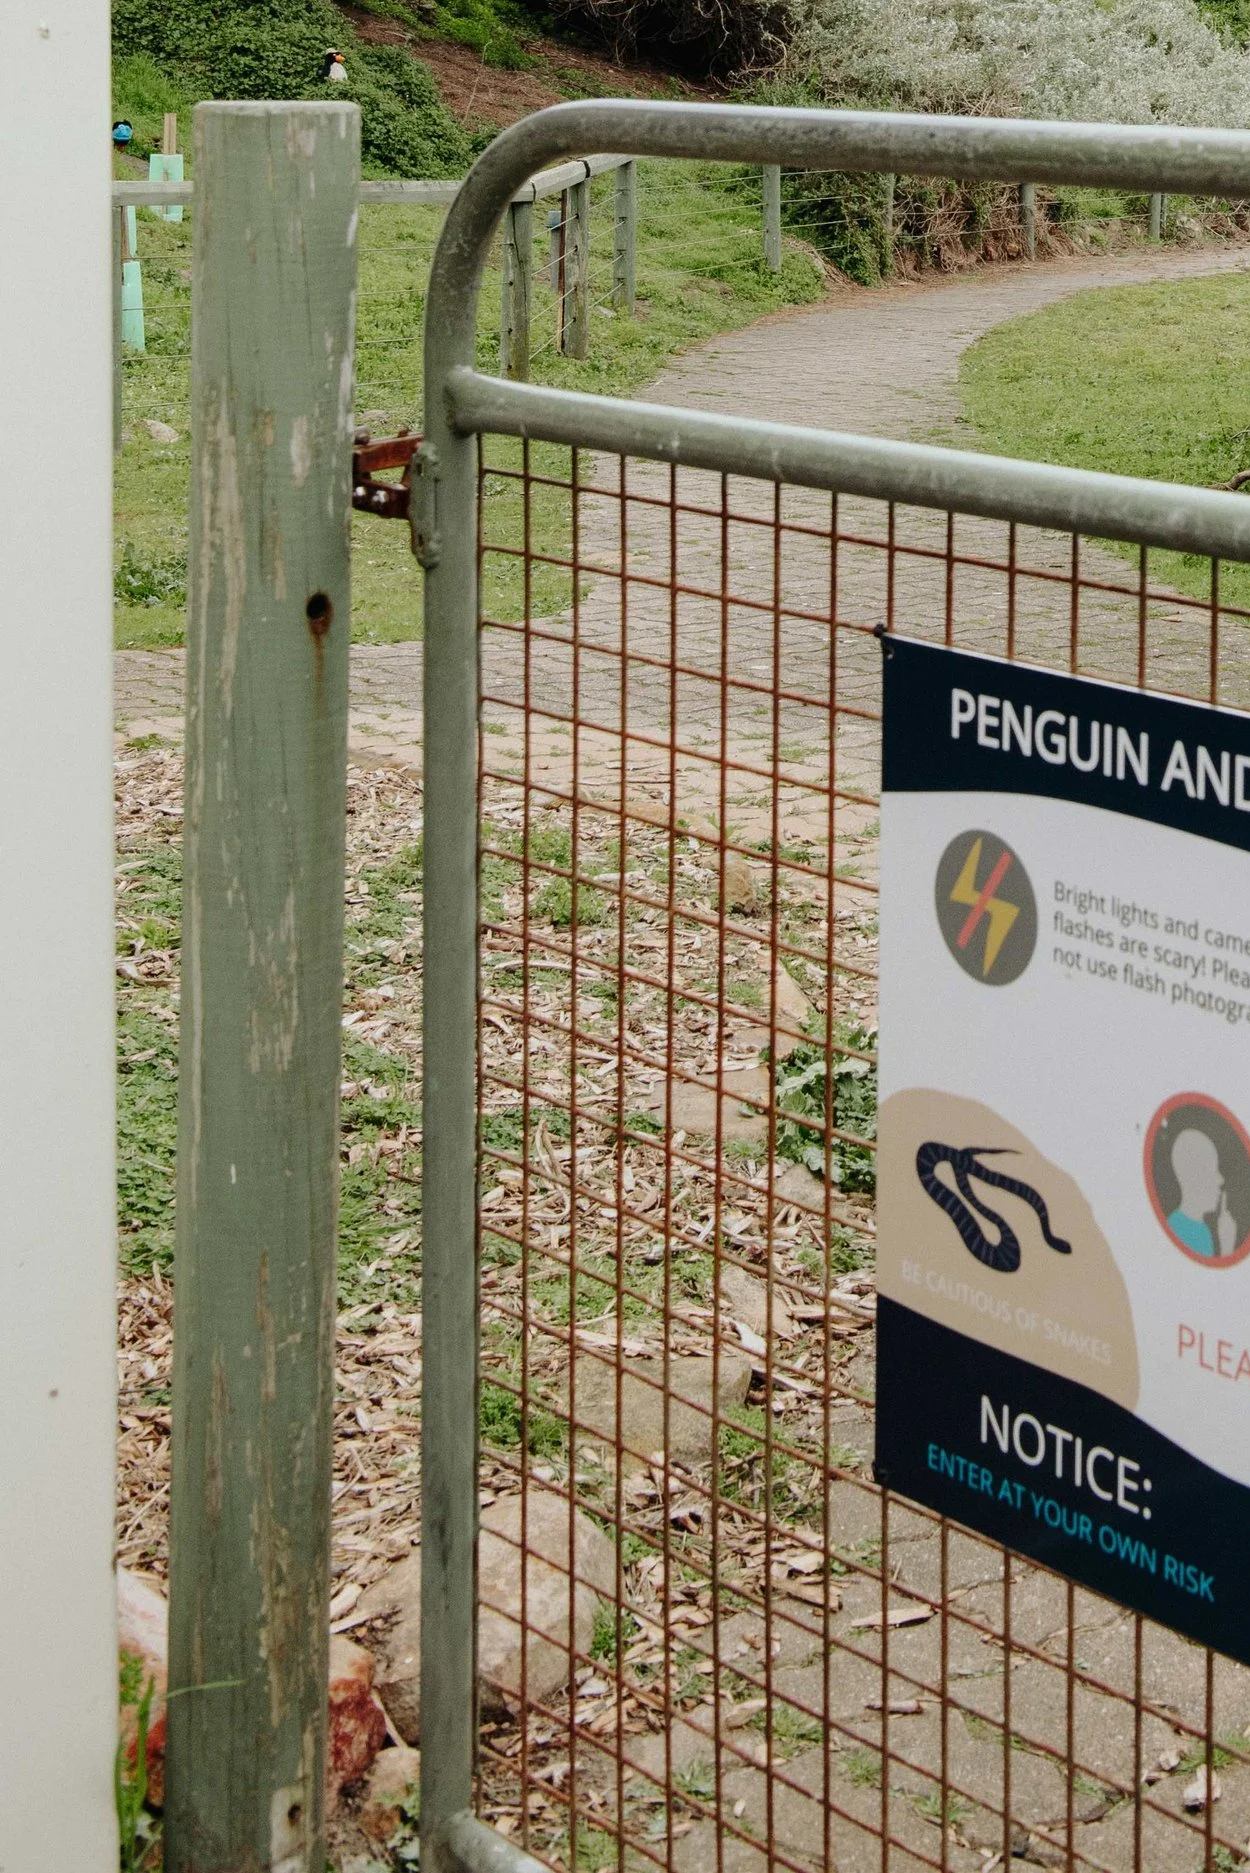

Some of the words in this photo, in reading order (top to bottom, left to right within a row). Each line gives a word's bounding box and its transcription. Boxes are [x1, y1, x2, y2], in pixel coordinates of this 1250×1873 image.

[951, 687, 1150, 787] PENGUIN
[1053, 879, 1107, 915] Bright
[1110, 894, 1159, 930] lights
[1164, 916, 1200, 941] and
[1053, 910, 1115, 949] flashes
[1118, 934, 1149, 958] are
[1152, 945, 1207, 979] scary!
[1052, 945, 1083, 972] not
[1086, 956, 1118, 981] use
[1122, 962, 1167, 996] flash
[901, 1258, 923, 1286] BE
[926, 1270, 1012, 1324] CAUTIOUS
[1015, 1304, 1040, 1333] OF
[1043, 1317, 1113, 1366] SNAKES
[980, 1394, 1152, 1520] NOTICE:
[927, 1443, 994, 1497] ENTER
[1000, 1478, 1027, 1511] AT
[1031, 1491, 1094, 1544] YOUR
[1099, 1524, 1157, 1574] OWN
[1163, 1554, 1216, 1604] RISK
